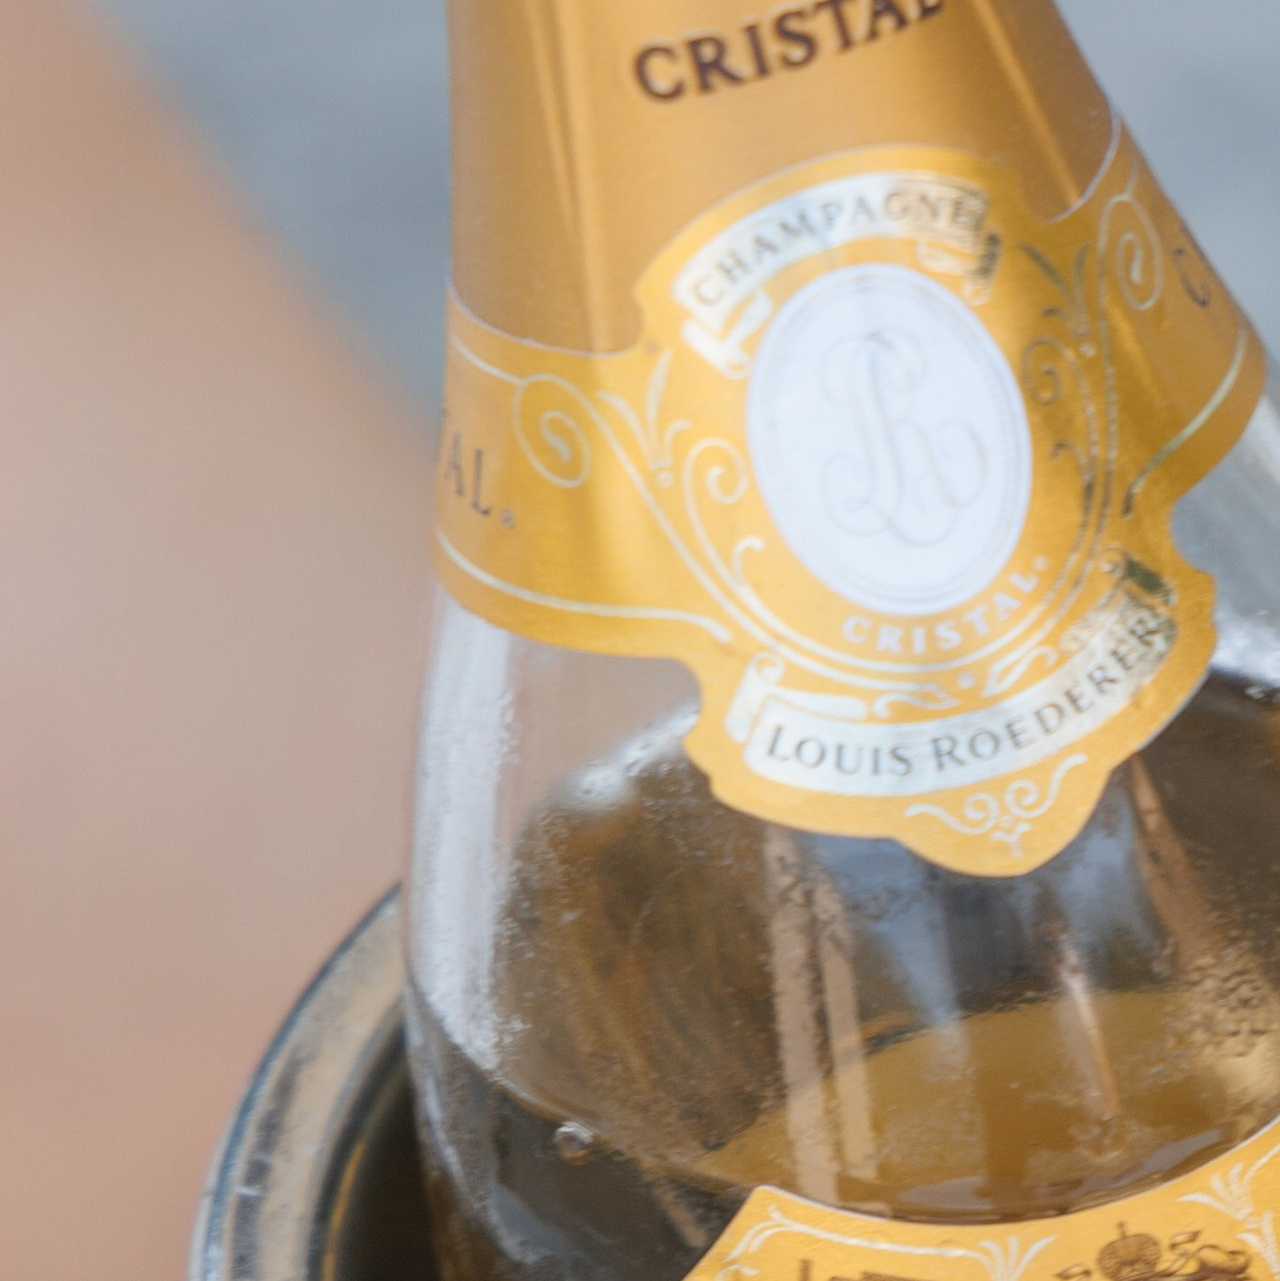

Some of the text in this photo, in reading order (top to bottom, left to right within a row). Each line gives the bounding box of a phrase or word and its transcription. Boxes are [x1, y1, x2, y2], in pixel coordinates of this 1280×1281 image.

[692, 190, 982, 307] CHAMPAGNE
[841, 571, 1038, 655] CRISTAL
[766, 611, 1165, 776] LOUIS ROEDERER
